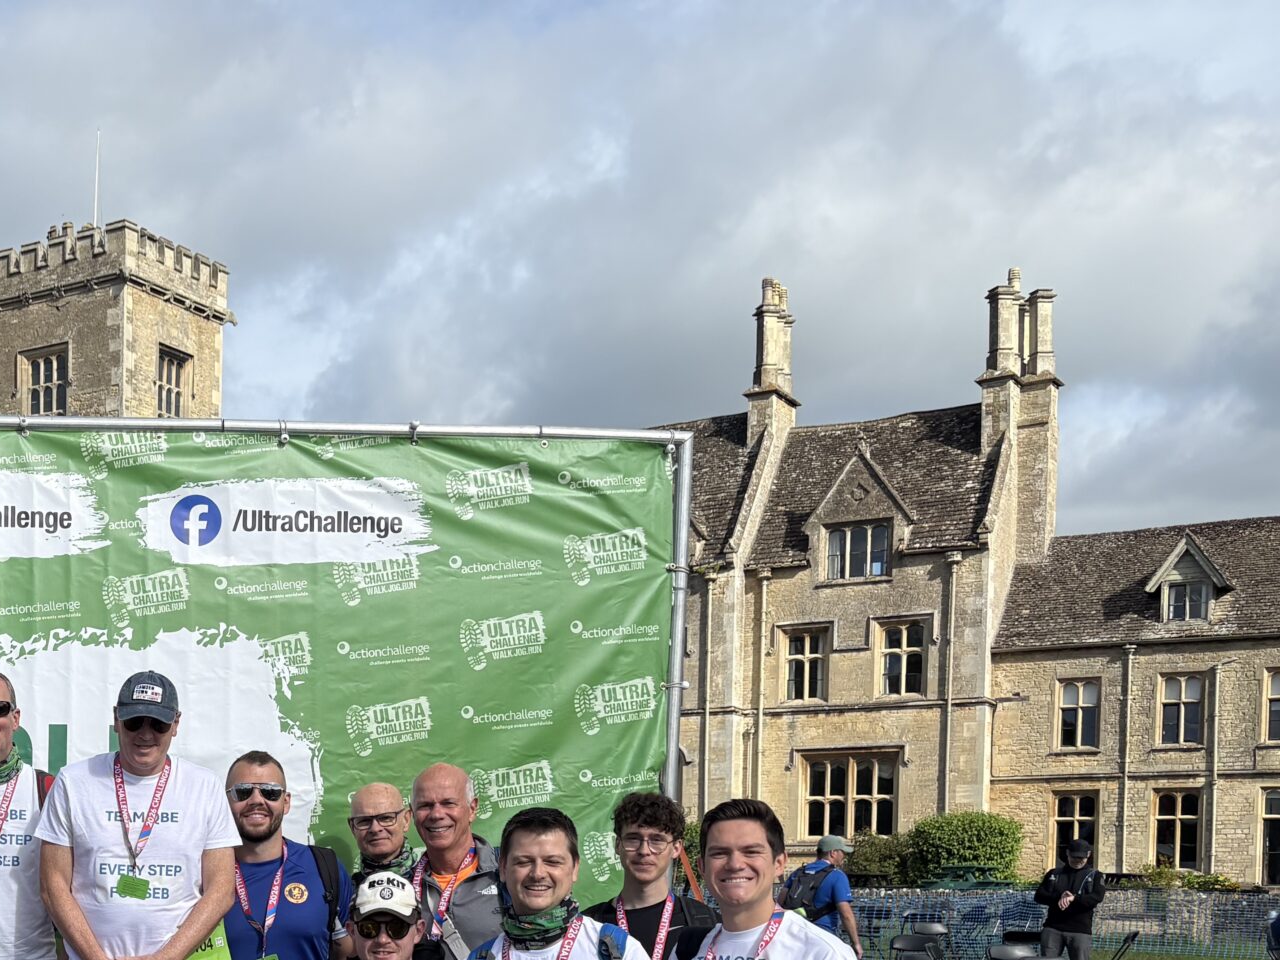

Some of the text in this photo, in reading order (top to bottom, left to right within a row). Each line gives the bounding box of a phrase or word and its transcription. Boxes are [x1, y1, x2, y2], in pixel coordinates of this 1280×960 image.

[111, 442, 164, 458] CHALLENGE
[113, 454, 165, 469] WALK.JOG.RUN
[473, 468, 526, 488] ULTRA
[570, 475, 646, 489] actionchallenge
[477, 484, 528, 500] CHALLENGE
[479, 495, 530, 510] WALK.JOG.RUN
[232, 509, 403, 539] /UltraChallenge
[590, 533, 642, 553] ULTRA
[361, 556, 414, 574] ULTRA
[593, 550, 643, 566] CHALLENGE
[461, 559, 542, 574] actionchallenge
[595, 562, 645, 575] WALK.JOG.RUN
[129, 574, 183, 595] ULTRA
[363, 570, 415, 585] CHALLENGE
[227, 579, 308, 595] actionchallenge
[366, 581, 417, 596] WALK.JOG.RUN
[132, 590, 185, 606] CHALLENGE
[0, 600, 81, 616] actionchallenge
[135, 602, 187, 617] WALK.JOG.RUN
[486, 616, 539, 638] ULTRA
[581, 624, 659, 639] actionchallenge
[489, 633, 541, 650] CHALLENGE
[349, 644, 430, 660] actionchallenge
[492, 645, 542, 661] WALK.JOG.RUN
[601, 682, 651, 703] ULTRA
[373, 703, 426, 724] ULTRA
[604, 699, 652, 715] CHALLENGE
[472, 708, 553, 724] actionchallenge
[606, 710, 653, 725] WALK.JOG.RUN
[376, 720, 427, 736] CHALLENGE
[378, 731, 429, 746] WALK.JOG.RUN
[495, 767, 547, 788] ULTRA
[146, 765, 171, 828] 2026 CHALLENGER
[497, 782, 549, 799] CHALLENGE
[499, 794, 550, 808] WALK.JOG.RUN
[0, 834, 33, 846] STEP
[99, 863, 182, 877] EVERY STEP
[567, 919, 581, 938] 2026
[763, 921, 779, 944] 2026
